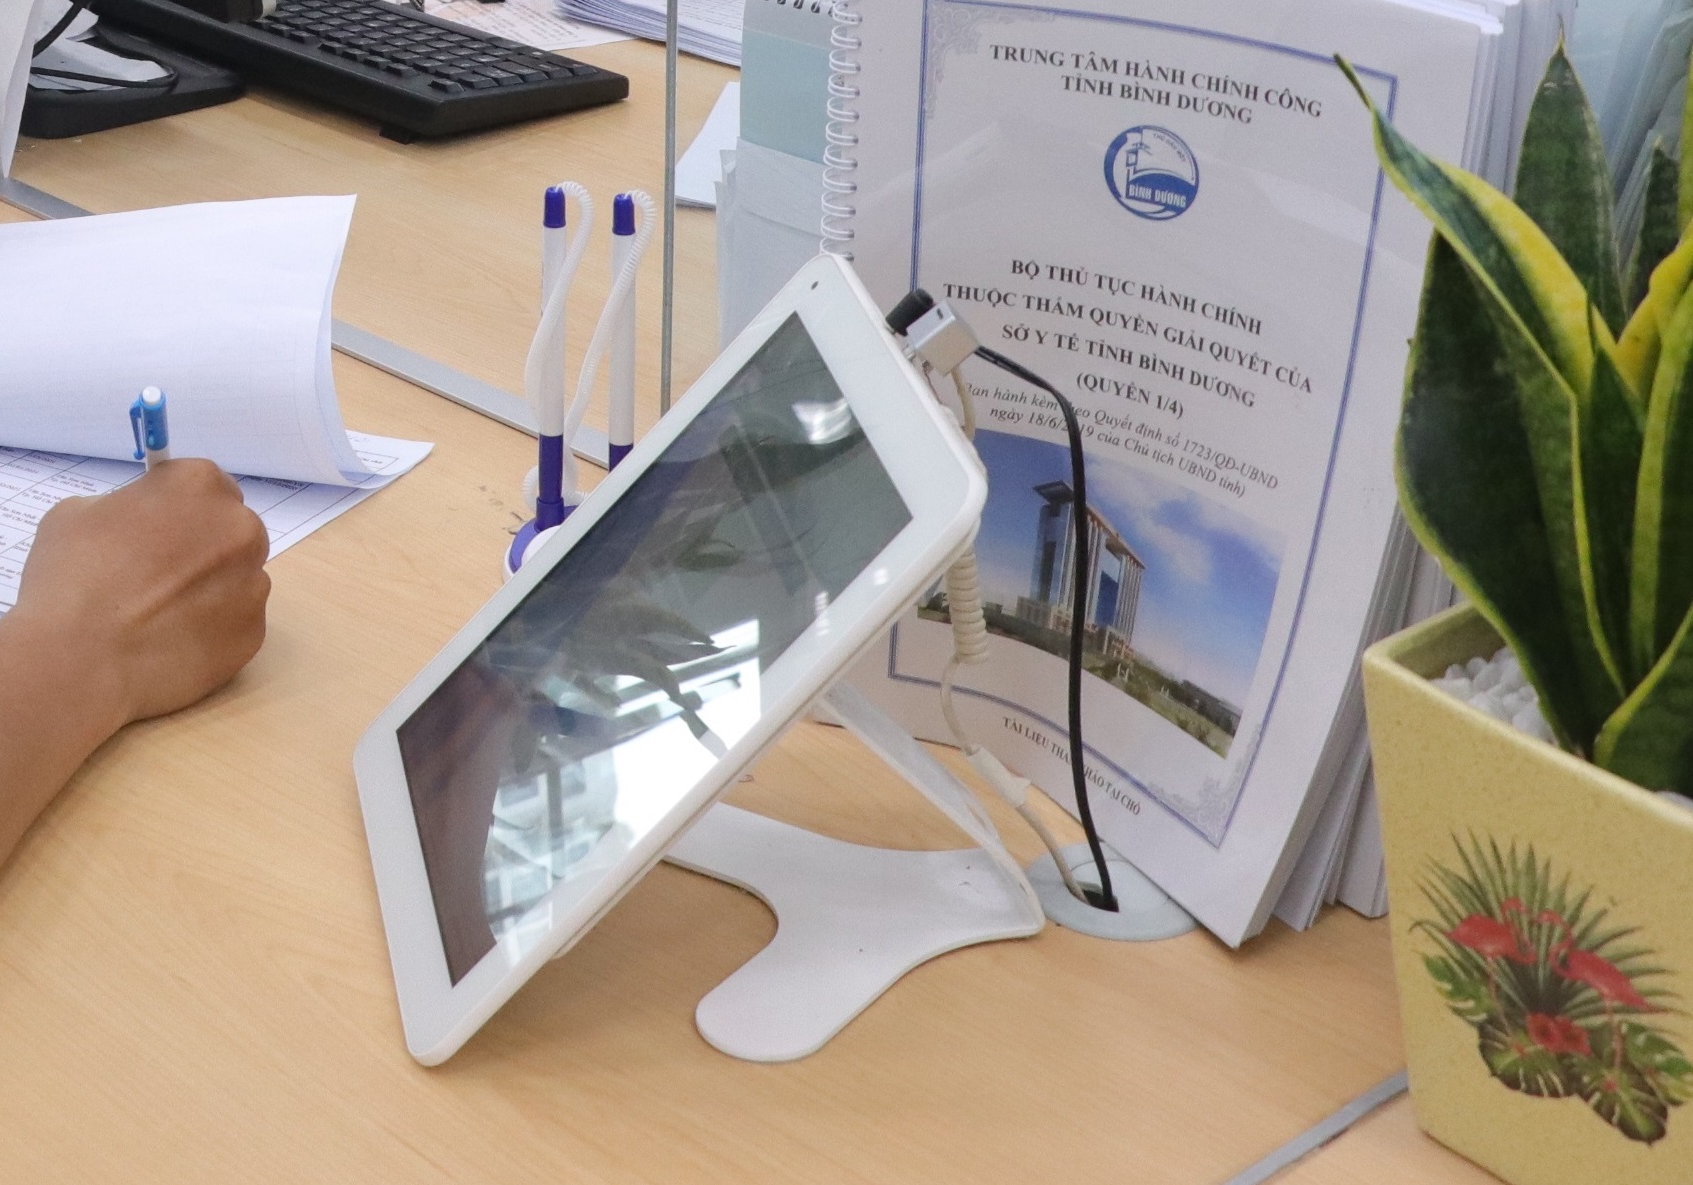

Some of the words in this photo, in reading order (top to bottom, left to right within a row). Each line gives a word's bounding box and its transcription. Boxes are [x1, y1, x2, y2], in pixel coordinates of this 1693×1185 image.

[989, 44, 1065, 67] TRUNG
[1071, 51, 1119, 74] TÂM
[1124, 59, 1185, 86] HÀNH
[1191, 73, 1260, 102] CHÍNH
[1264, 88, 1322, 117] CÔNG
[1061, 73, 1115, 96] TỈNH
[1119, 81, 1171, 107] BÌNH
[1176, 93, 1253, 124] DƯƠNG
[1129, 183, 1152, 200] BÌNH
[1154, 189, 1187, 208] DƯƠNG
[1010, 259, 1040, 280] BỘ
[1045, 264, 1090, 286] THỦ
[1093, 273, 1136, 296] TỤC
[1140, 284, 1198, 314] HÀNH
[1201, 302, 1262, 336] CHÍNH
[943, 283, 1017, 308] THUỘC
[1022, 294, 1085, 319] THẨM
[1089, 307, 1159, 337] QUYỀN
[1163, 326, 1206, 352] GIẢI
[1209, 341, 1273, 376] QUYẾT
[1275, 366, 1313, 394] CỦA
[1001, 323, 1031, 342] SỞ
[1034, 329, 1049, 345] Y
[1054, 332, 1081, 352] TẾ
[1085, 338, 1134, 365] TỈNH
[1138, 353, 1185, 382] BÌNH
[1189, 369, 1256, 408] DƯƠNG
[993, 387, 1028, 405] hành
[1031, 394, 1059, 410] kèm
[1094, 409, 1132, 431] Quyết
[1135, 422, 1163, 442] định
[1165, 432, 1182, 448] số
[1183, 438, 1278, 489] 1723/QĐ-UBND
[1156, 393, 1184, 419] 1/4)
[990, 407, 1024, 424] ngày
[1028, 412, 1095, 437] 18/6/219
[1097, 431, 1120, 446] của
[1124, 437, 1150, 456] Chủ
[1152, 447, 1175, 466] tịch
[1178, 457, 1218, 483] UBND
[1218, 476, 1246, 498] tỉnh)
[1003, 717, 1023, 735] TÀI
[1024, 727, 1051, 748] LIỆU
[1051, 743, 1072, 765] THA
[1106, 781, 1122, 801] TẠI
[1121, 795, 1141, 816] CHỖ
